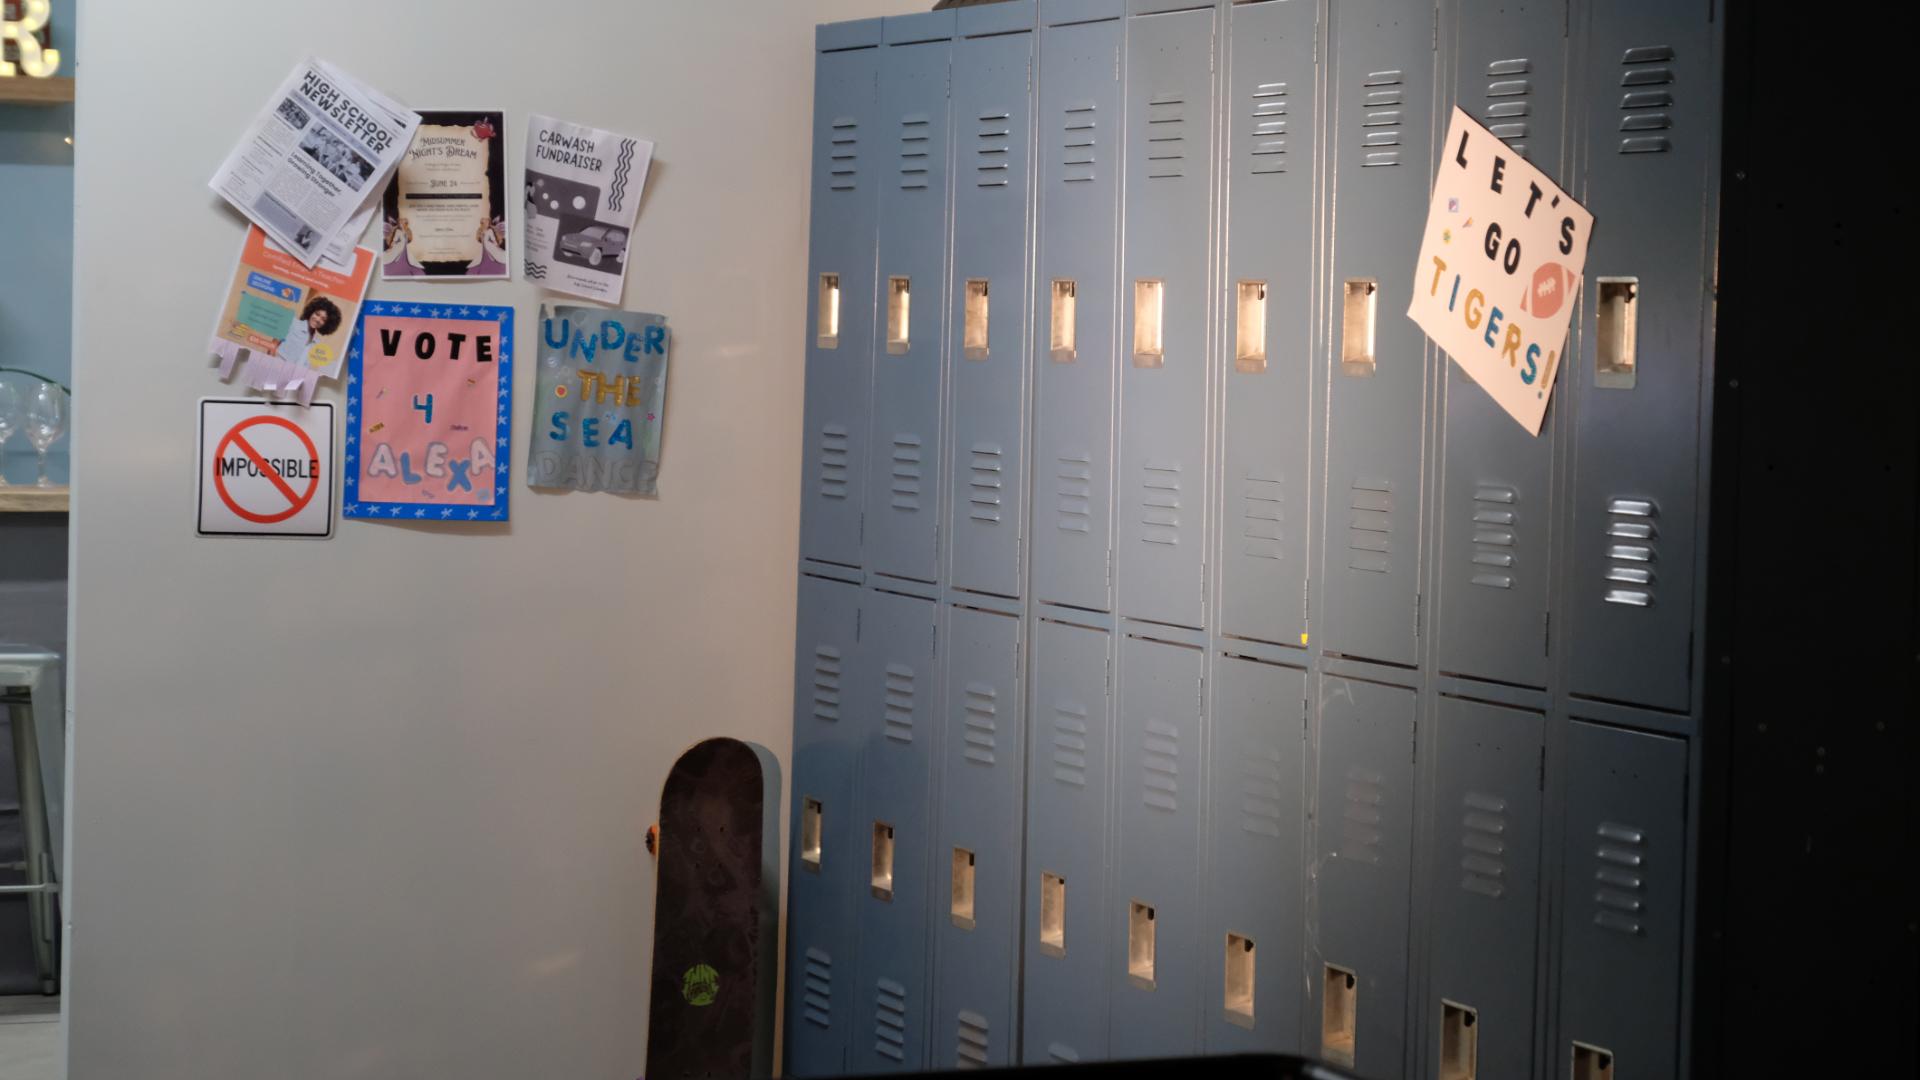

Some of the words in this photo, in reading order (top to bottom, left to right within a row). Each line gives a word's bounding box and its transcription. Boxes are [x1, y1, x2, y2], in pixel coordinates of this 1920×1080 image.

[0, 0, 60, 78] R
[300, 82, 385, 154] NEWSLETTER
[304, 71, 341, 103] HIGH
[340, 99, 393, 148] SCHOOL
[536, 144, 603, 172] FUNDRAISER
[539, 129, 596, 154] CARWASH
[1455, 129, 1576, 255] LET'S
[1484, 222, 1521, 275] GO
[380, 329, 493, 362] VOTE
[544, 318, 665, 363] UNDER
[1431, 255, 1556, 399] TIGERS!
[413, 393, 433, 424] 4
[576, 369, 641, 407] THE
[550, 411, 634, 450] SEA
[367, 436, 496, 493] ALEXA
